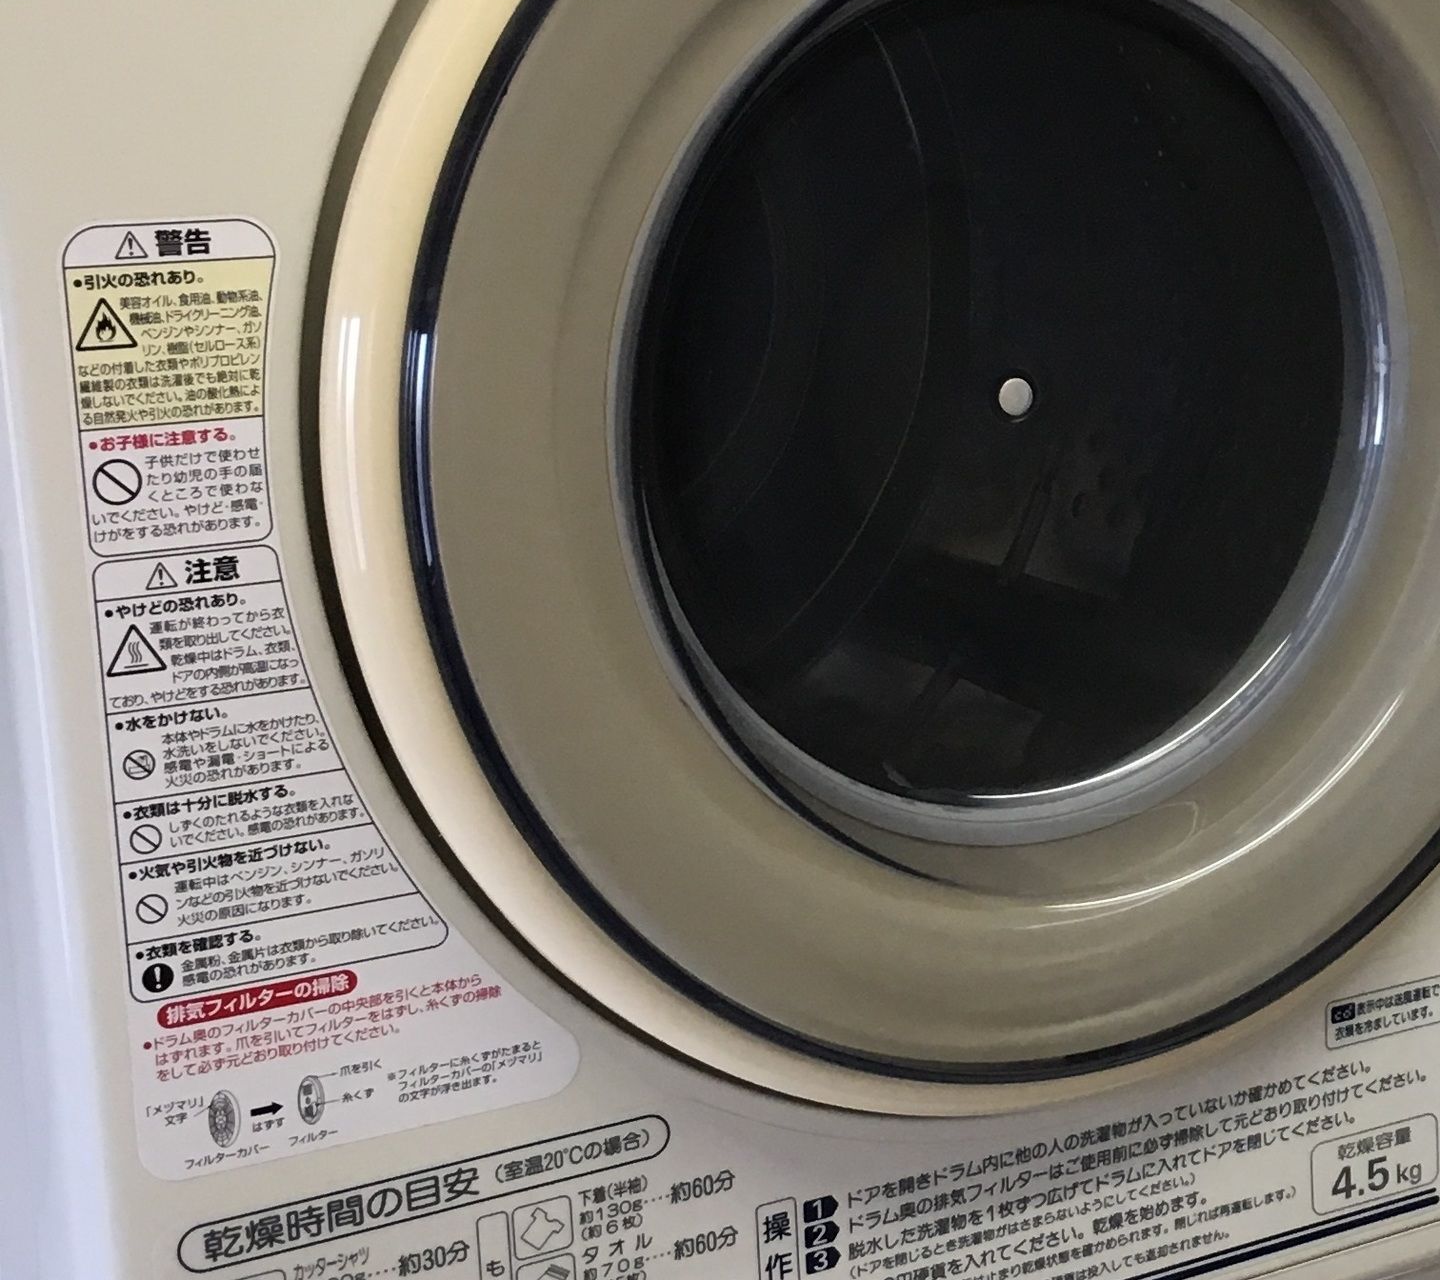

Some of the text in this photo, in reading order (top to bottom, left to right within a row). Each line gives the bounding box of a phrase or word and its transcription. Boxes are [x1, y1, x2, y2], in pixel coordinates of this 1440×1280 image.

[155, 229, 211, 256] 警告
[84, 270, 204, 290] 引火の恐れあり。
[100, 428, 236, 452] お子様に注意する。
[184, 556, 240, 585] 注意
[116, 593, 246, 618] やけどの恐れあり。
[126, 706, 228, 731] 水をかけない。
[140, 840, 331, 880] 火気や引火物を近づけない。
[145, 931, 262, 960] 衣類を確認する。
[166, 974, 349, 1025] 排気フィルターの掃除
[289, 1129, 338, 1146] フィルター
[1338, 1127, 1411, 1160] 乾燥容量
[184, 1144, 269, 1170] フィルターカバー
[671, 1169, 735, 1204] 約60分
[1331, 1156, 1422, 1201] 4.5 kg
[203, 1166, 480, 1262] 乾燥時間の目安
[812, 1200, 823, 1217] 1
[674, 1225, 738, 1260] 約60分
[813, 1226, 827, 1243] 2
[398, 1240, 470, 1278] 約30分
[814, 1252, 828, 1270] 3
